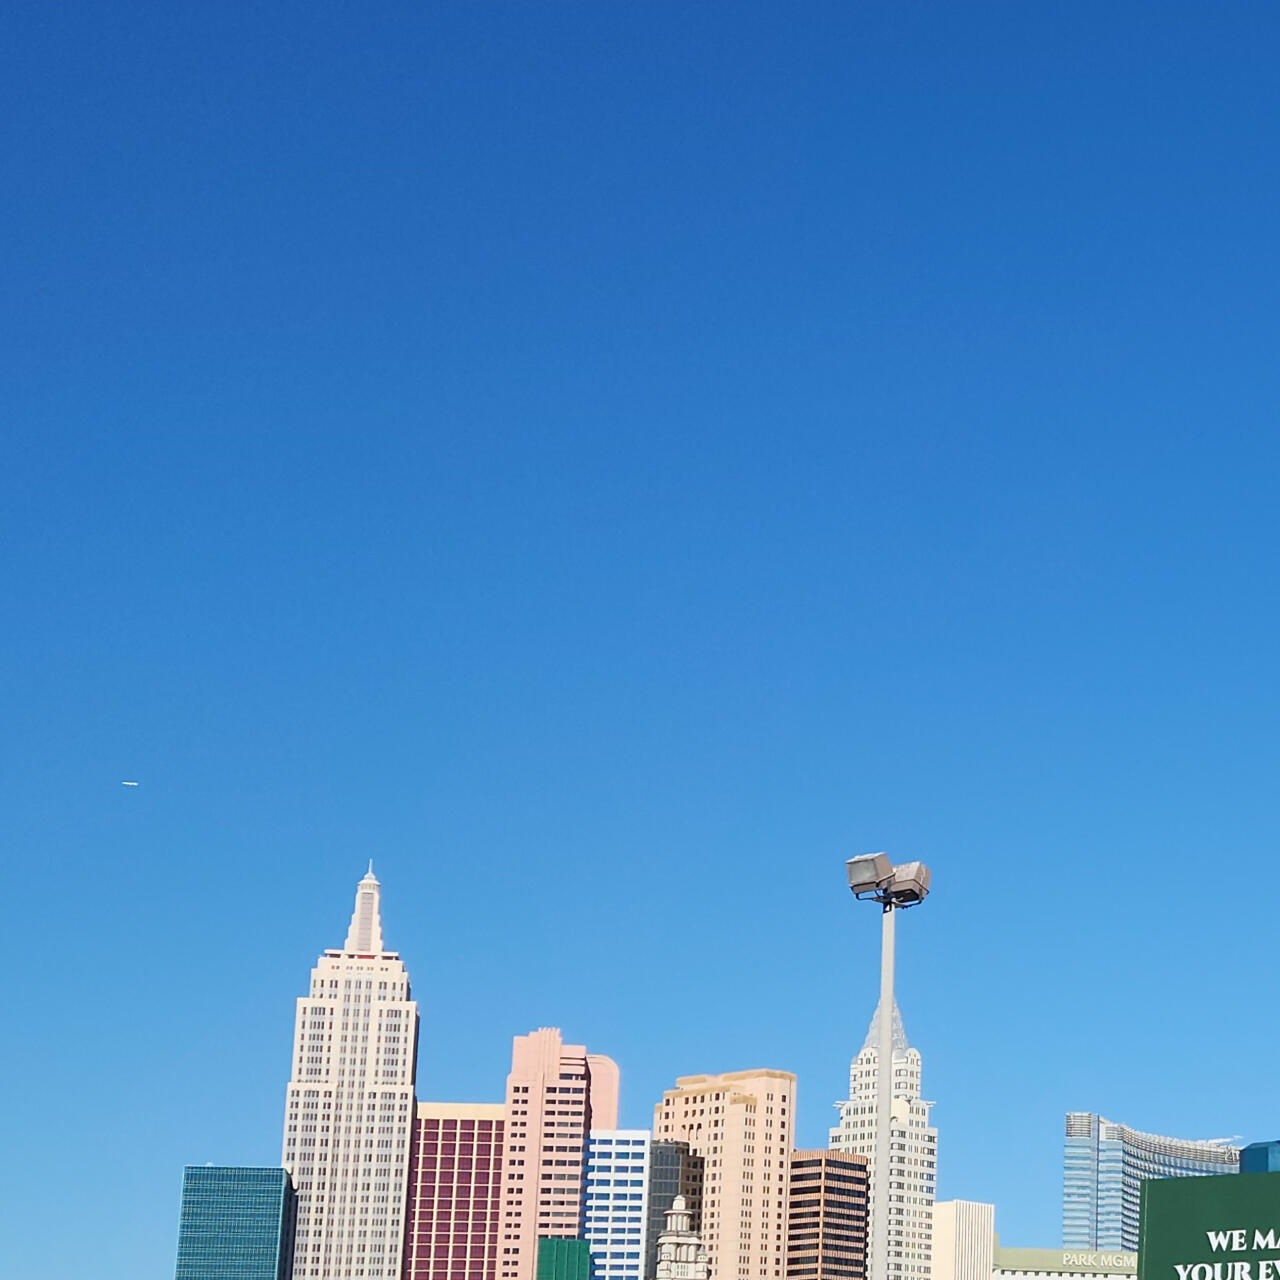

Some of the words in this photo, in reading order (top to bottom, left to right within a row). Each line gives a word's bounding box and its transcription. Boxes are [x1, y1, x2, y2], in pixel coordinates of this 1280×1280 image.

[1206, 1229, 1247, 1252] WE
[1062, 1252, 1097, 1266] PARK
[1101, 1254, 1135, 1267] MGM
